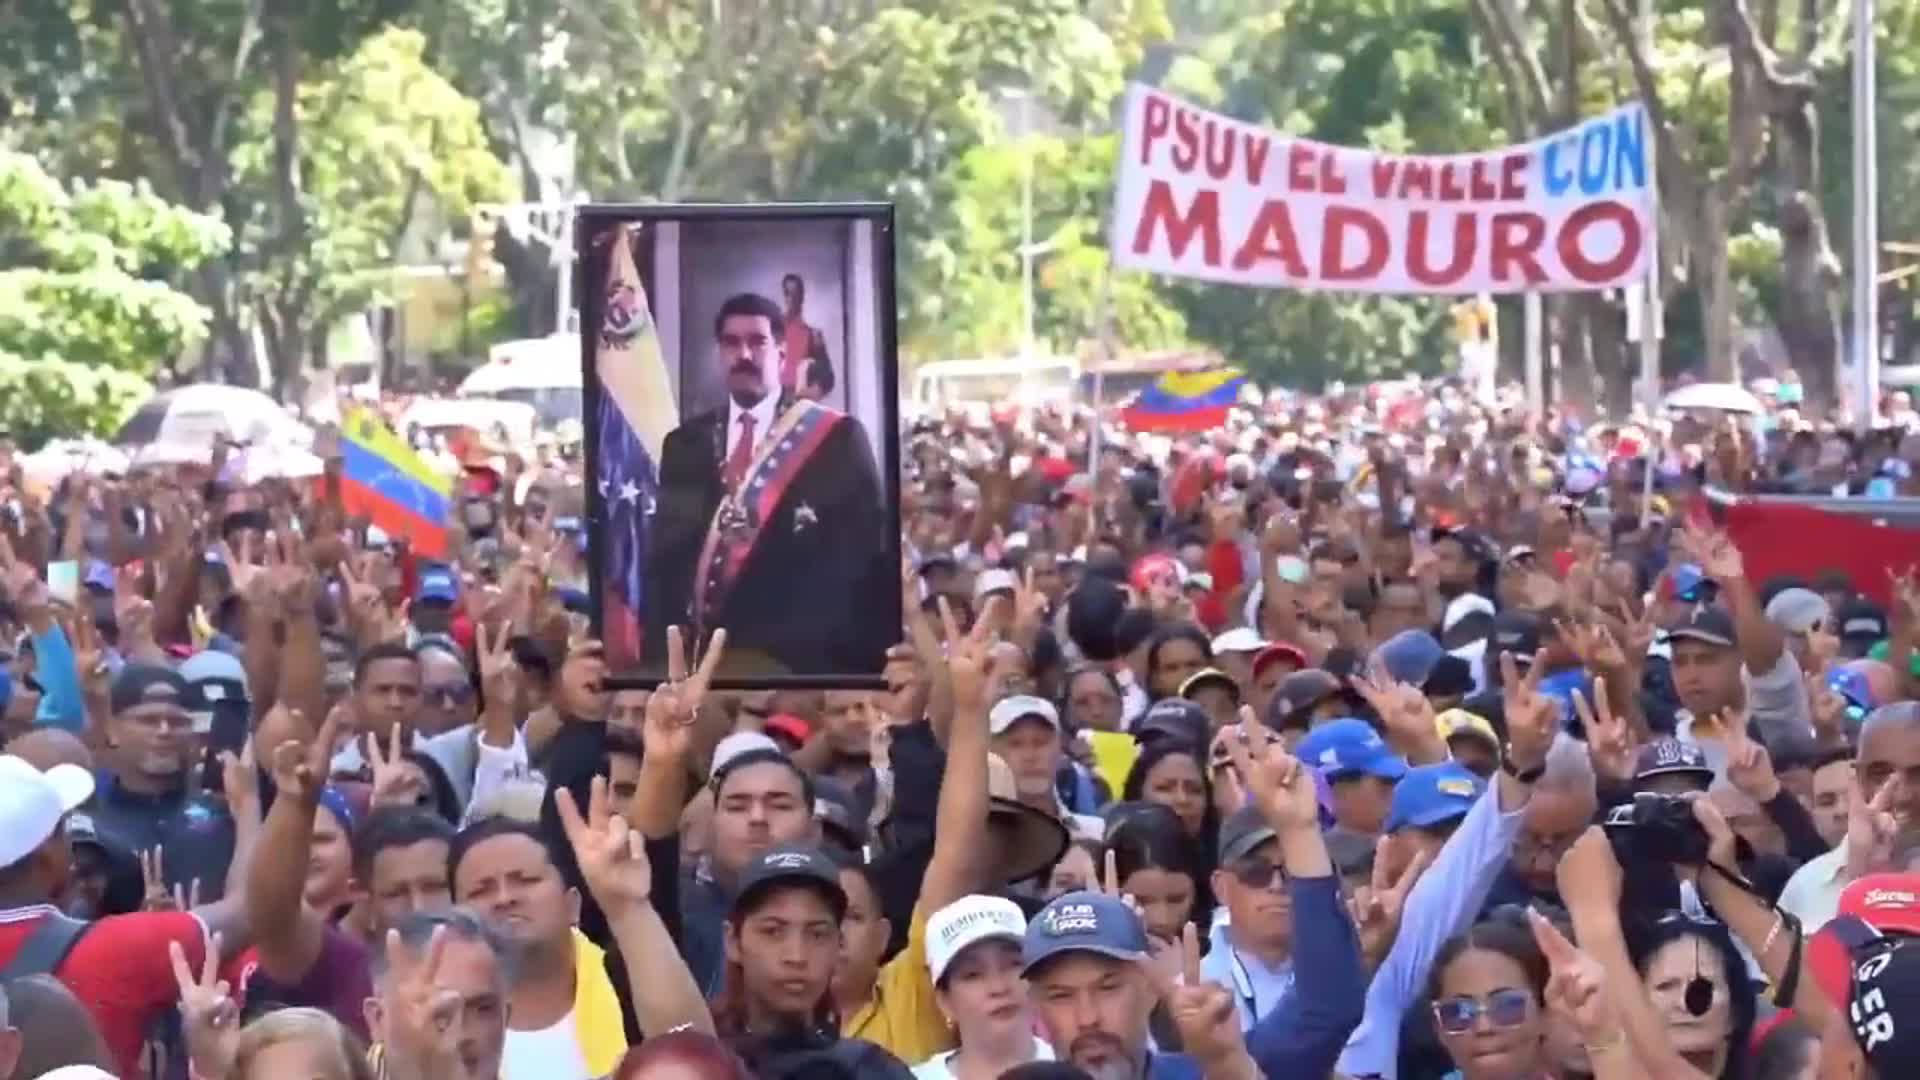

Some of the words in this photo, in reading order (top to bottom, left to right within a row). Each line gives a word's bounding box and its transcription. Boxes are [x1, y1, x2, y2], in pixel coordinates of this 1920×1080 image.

[1141, 95, 1270, 186] PSUV
[1288, 143, 1346, 194] EL
[1543, 107, 1645, 197] CON
[1132, 180, 1641, 286] MADURO
